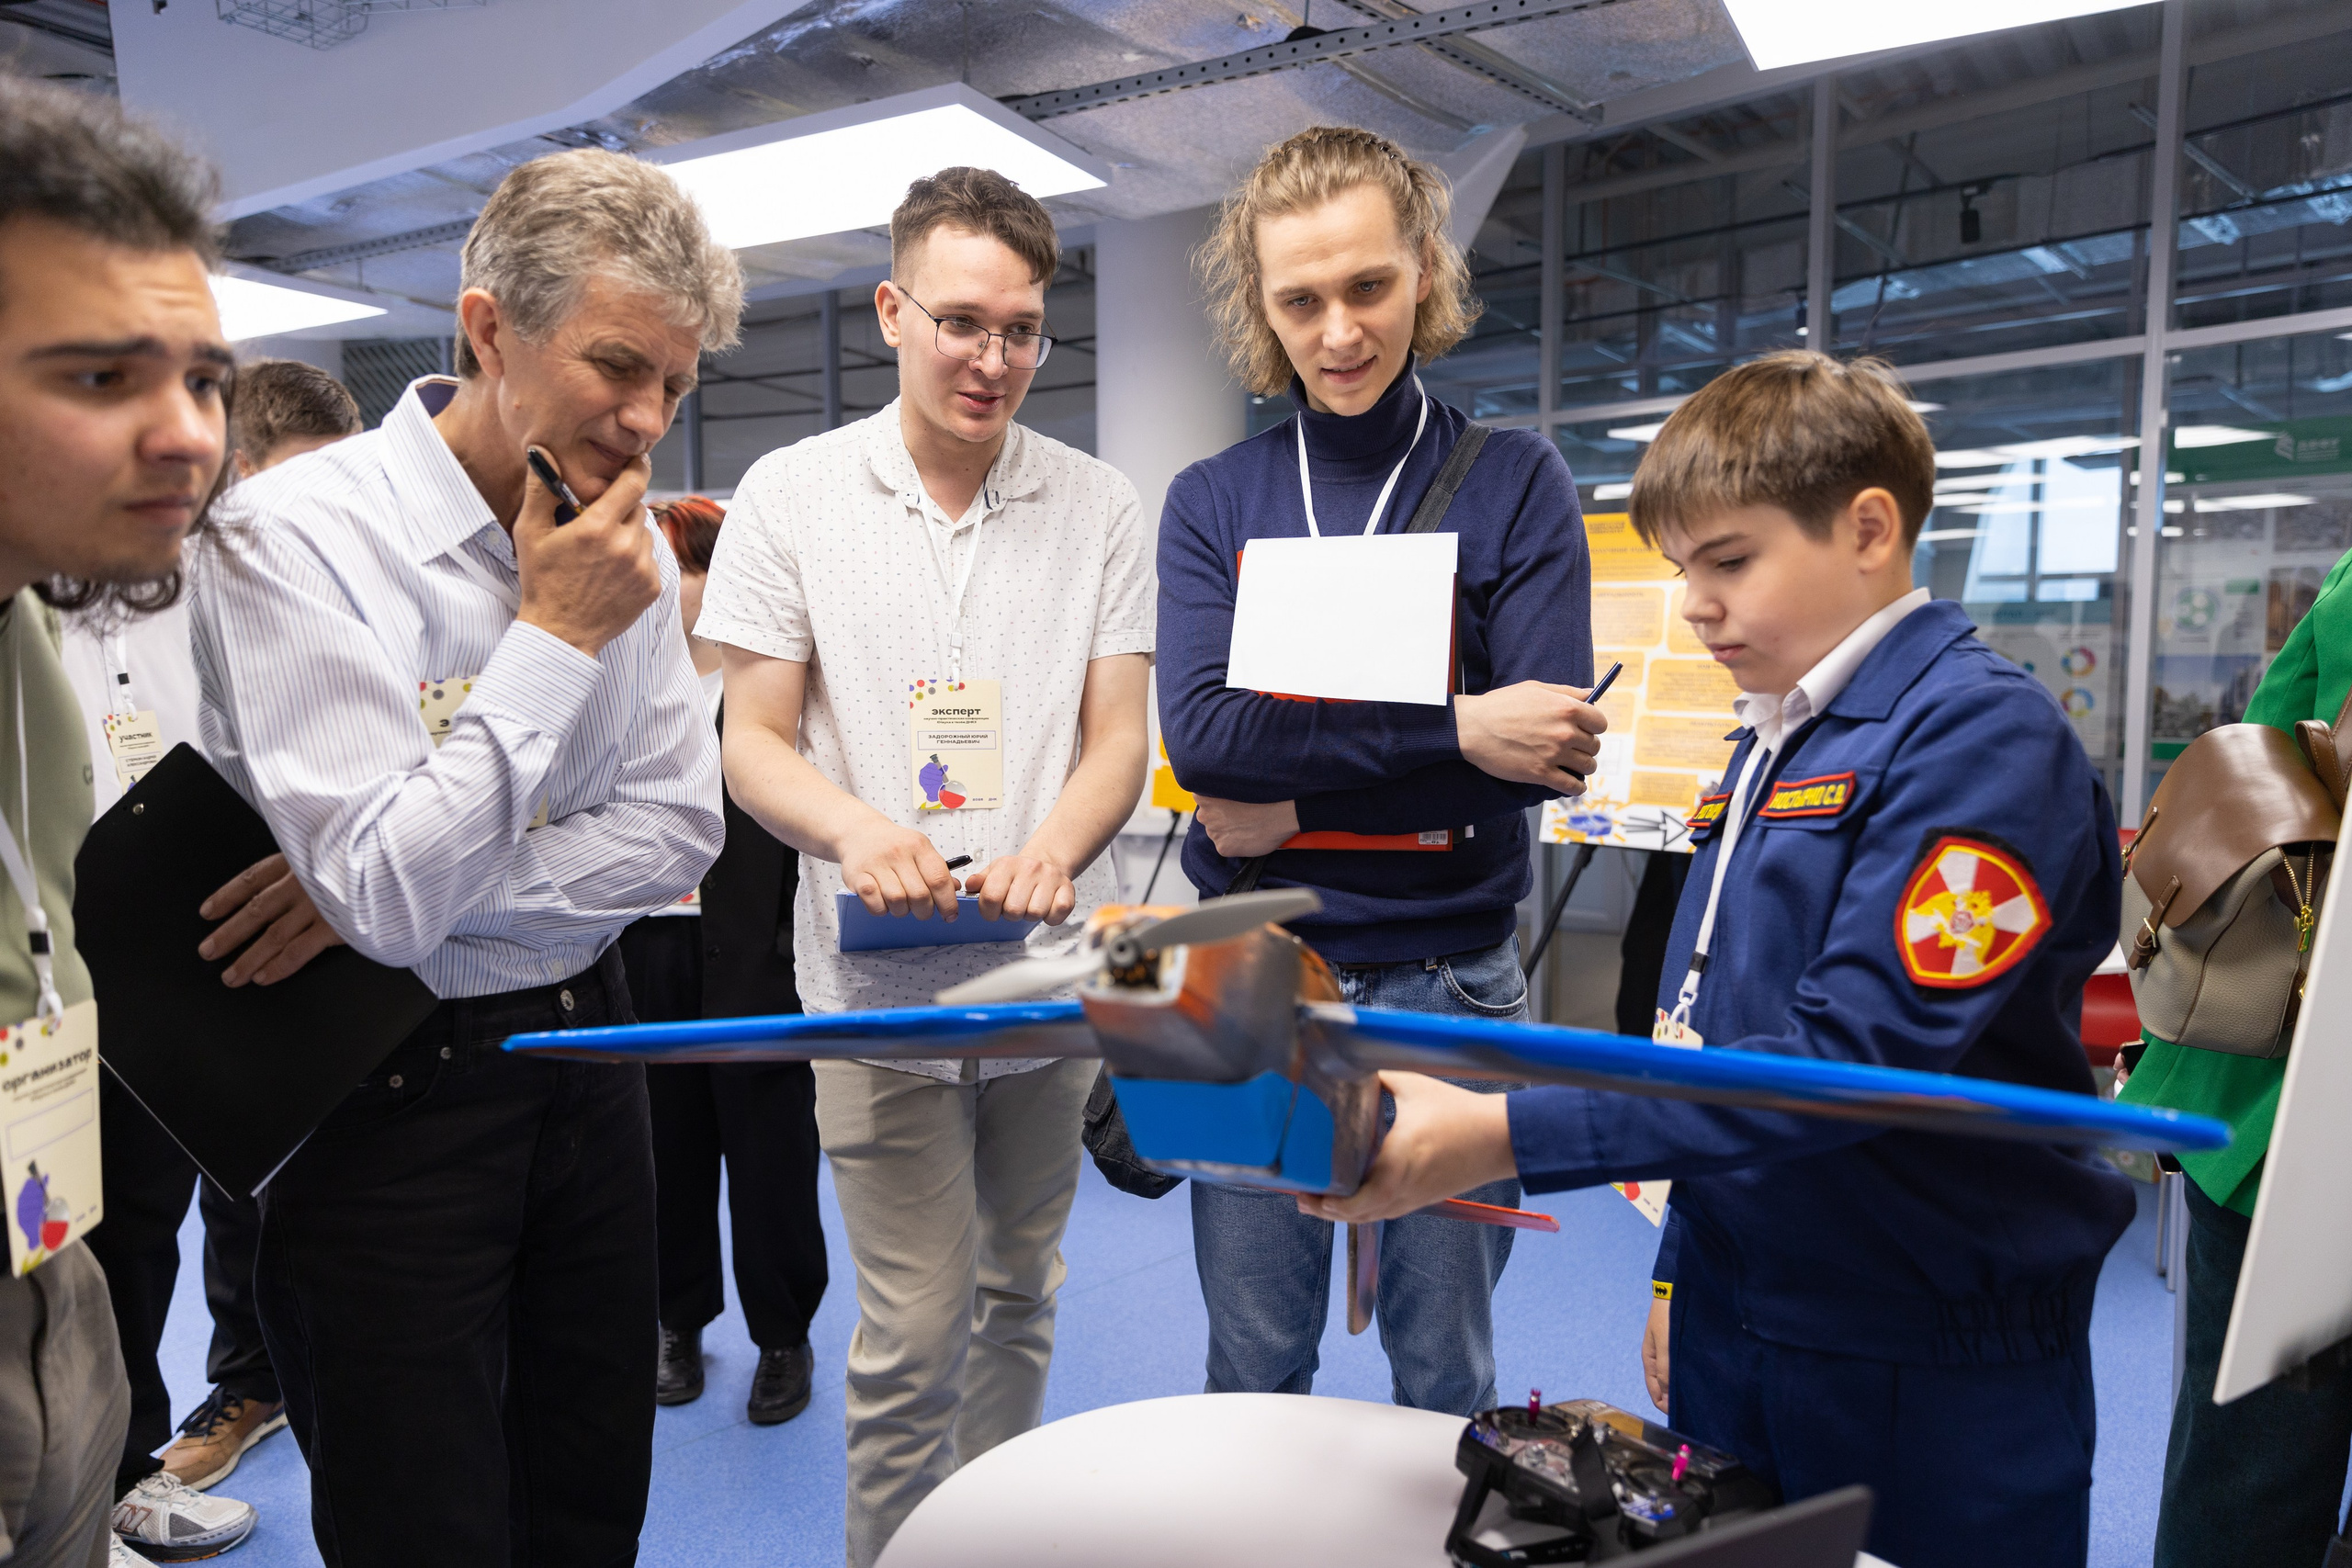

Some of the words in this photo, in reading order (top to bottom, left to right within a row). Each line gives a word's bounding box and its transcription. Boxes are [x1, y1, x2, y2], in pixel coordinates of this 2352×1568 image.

[932, 708, 981, 716] эксперт
[119, 732, 153, 743] участник
[3, 1047, 92, 1092] организатор
